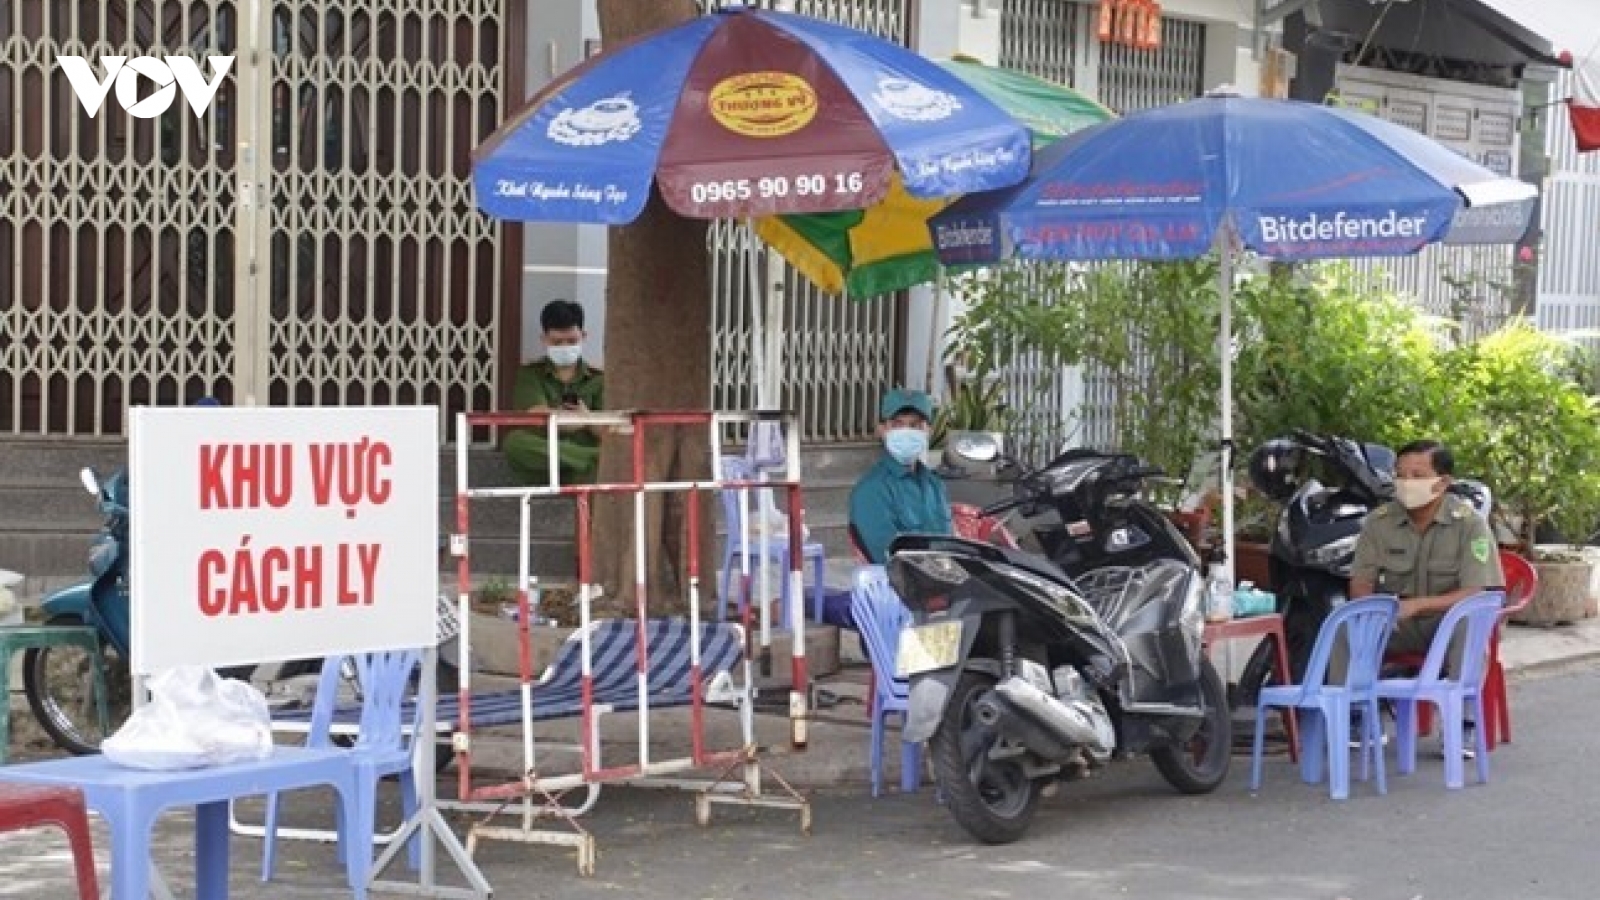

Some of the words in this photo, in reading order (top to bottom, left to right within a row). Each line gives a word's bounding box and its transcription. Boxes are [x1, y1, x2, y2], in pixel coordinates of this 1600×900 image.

[691, 179, 750, 203] 0965
[758, 177, 788, 198] 90
[795, 174, 826, 196] 90
[834, 172, 863, 193] 16
[1259, 209, 1427, 243] Bitdefender
[199, 443, 293, 510] KHU
[308, 435, 392, 520] VỰC
[198, 533, 323, 617] CÁCH
[336, 543, 382, 606] LY
